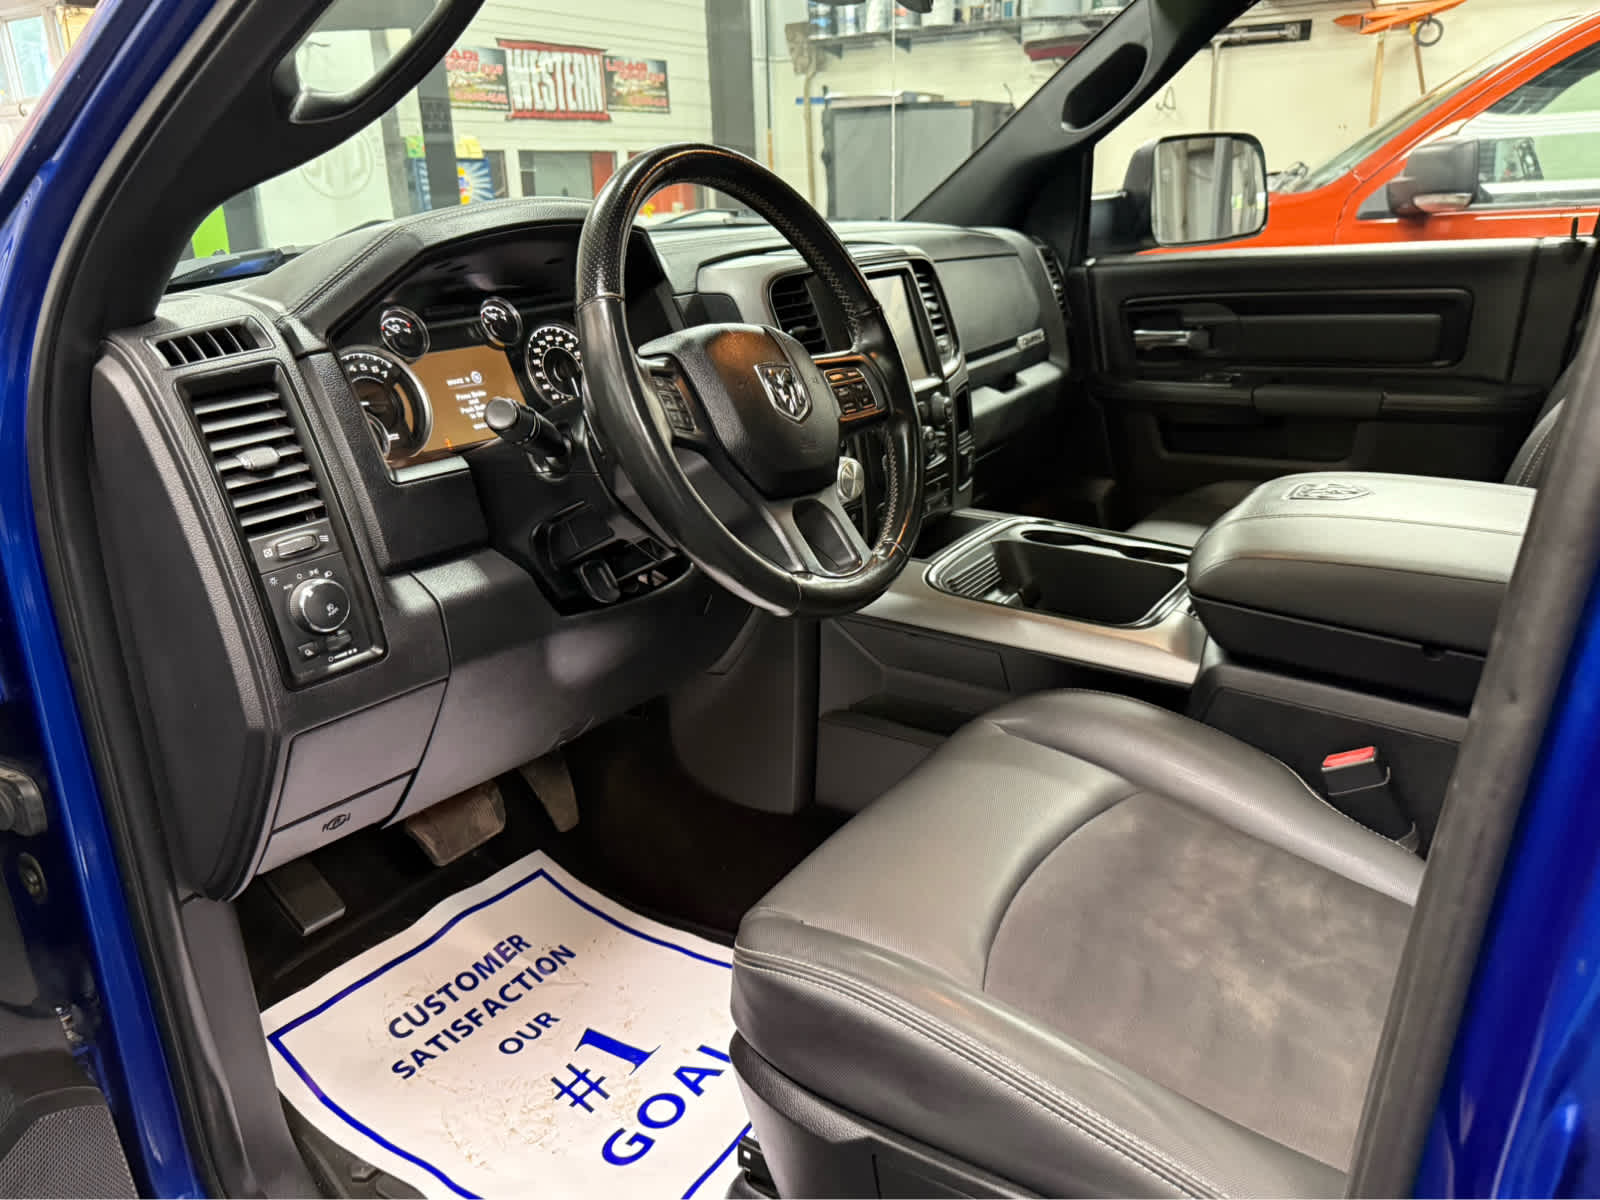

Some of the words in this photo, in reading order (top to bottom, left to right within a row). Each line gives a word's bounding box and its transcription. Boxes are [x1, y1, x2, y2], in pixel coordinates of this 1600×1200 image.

[506, 48, 604, 112] WESTERN
[389, 934, 532, 1040] CUSTOMER
[391, 943, 578, 1081] SATISFACTION
[498, 1012, 562, 1056] OUR
[550, 1027, 661, 1114] #1
